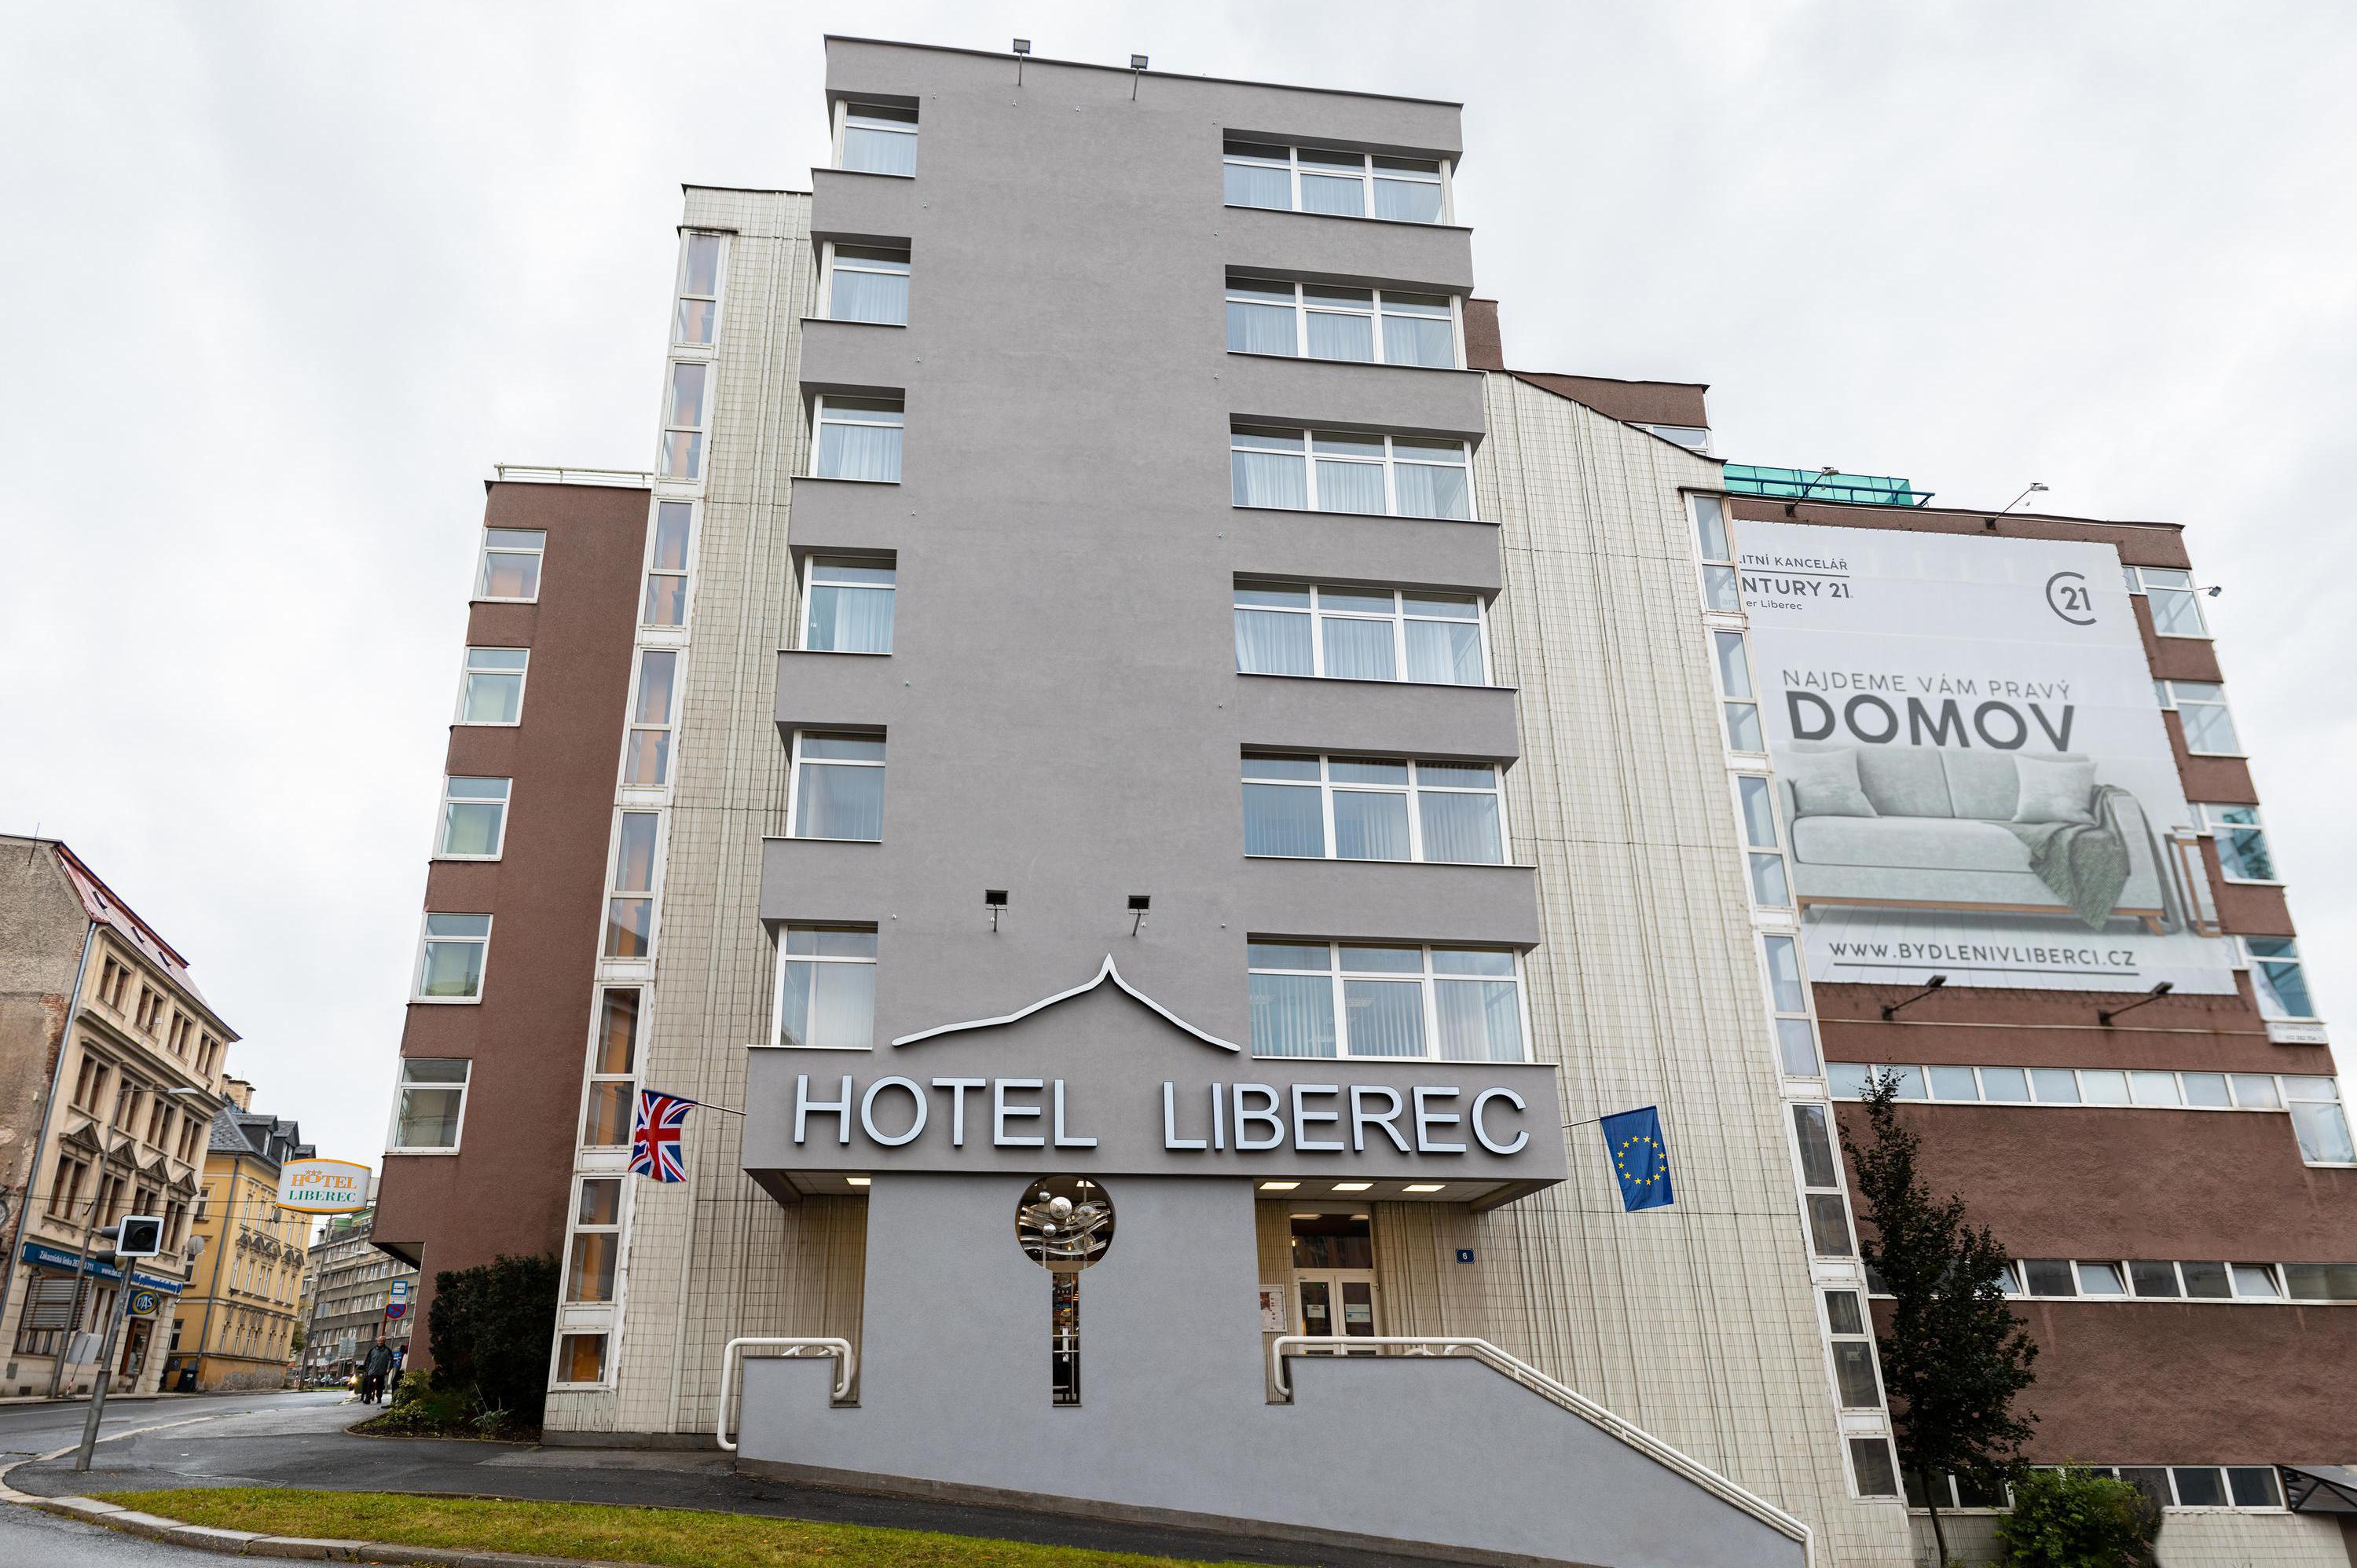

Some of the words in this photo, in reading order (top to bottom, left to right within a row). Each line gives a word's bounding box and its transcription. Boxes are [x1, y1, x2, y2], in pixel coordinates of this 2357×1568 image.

[1739, 554, 1769, 566] ITNÍ
[1774, 557, 1848, 570] KANCELÁŘ
[1828, 582, 1850, 599] 21
[1761, 599, 1803, 610] Liberec
[1782, 669, 1908, 693] NAJDEME
[1917, 672, 1978, 696] VÁM
[1988, 680, 2071, 701] PRAVÝ
[1785, 690, 2076, 753] DOMOV
[1828, 942, 2137, 967] WWW.BYDLENIVLIBERCI.CZ
[793, 1073, 1098, 1148] HOTEL
[1163, 1080, 1530, 1156] LIBEREC
[290, 1172, 357, 1189] HOTEL
[288, 1189, 357, 1203] LIBEREC
